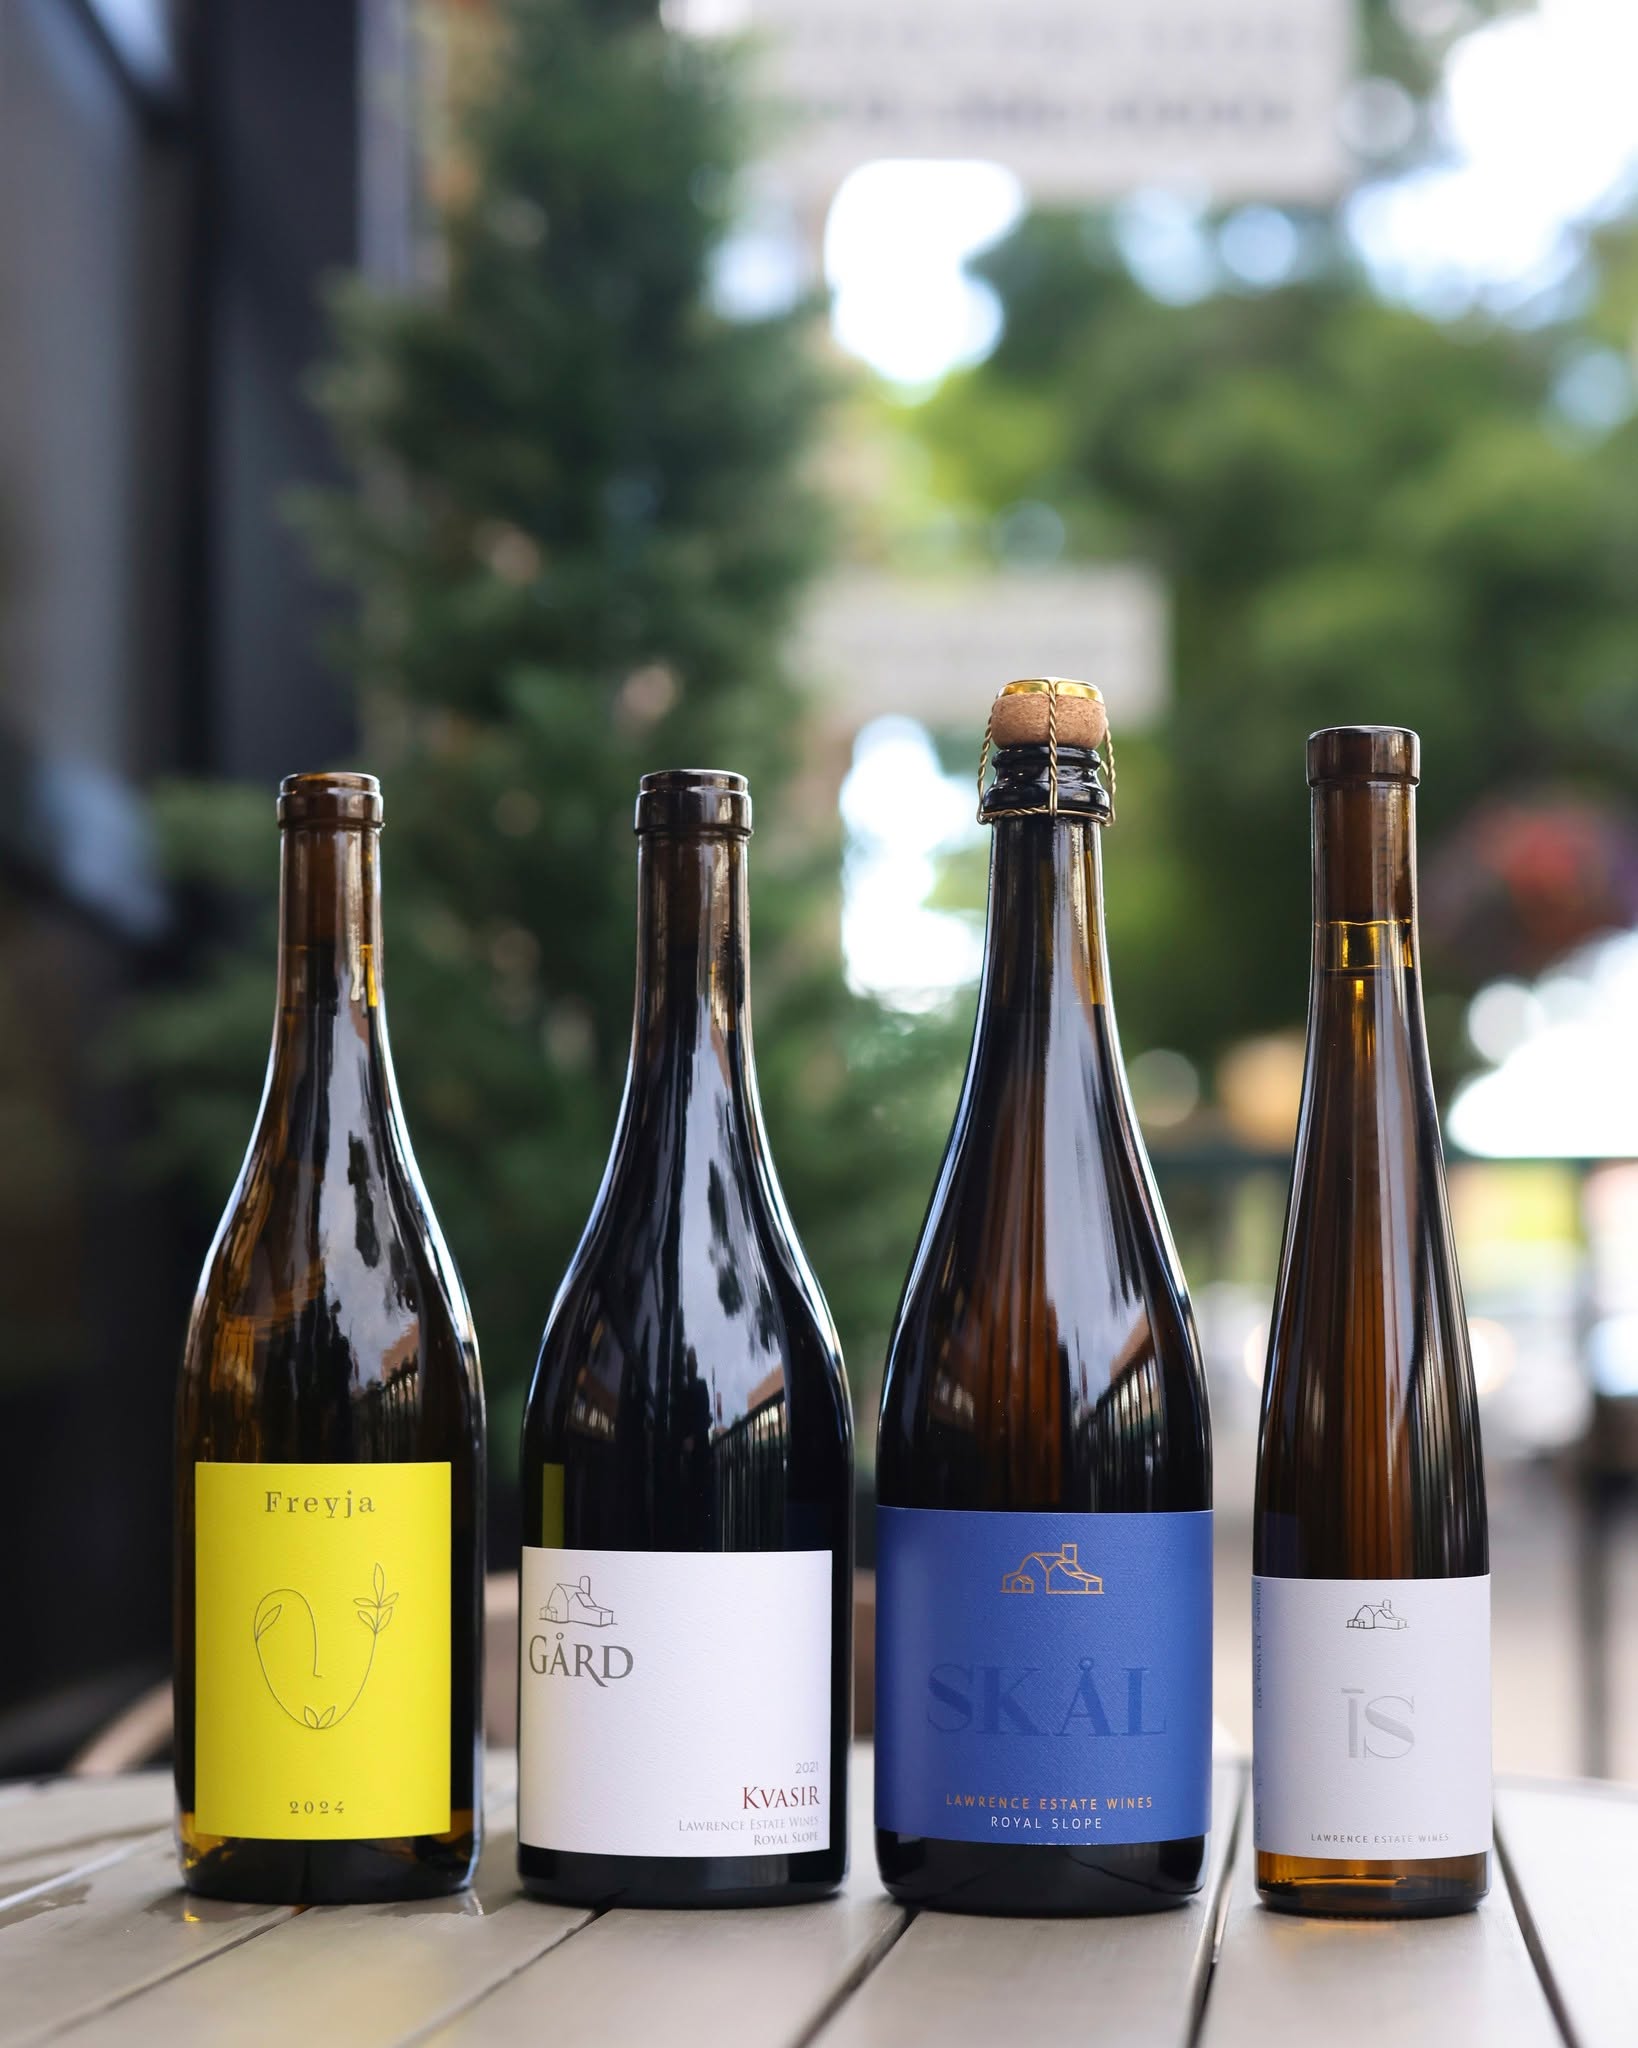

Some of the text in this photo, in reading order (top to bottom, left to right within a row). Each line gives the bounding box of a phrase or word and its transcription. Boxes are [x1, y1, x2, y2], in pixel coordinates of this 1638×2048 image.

[264, 1489, 376, 1518] Freyja
[528, 1631, 635, 1688] GÅRD
[927, 1656, 1168, 1738] SKÅL
[795, 1761, 819, 1774] 2021
[742, 1785, 820, 1810] KVASIR
[946, 1794, 1153, 1811] LAWRENCE ESTATE WINES
[289, 1801, 345, 1815] 2024
[679, 1815, 819, 1832] LAWRENCE ESTATE WINES
[991, 1816, 1103, 1831] ROYAL SLOPE
[754, 1831, 819, 1846] ROYAL SLOPE
[1311, 1833, 1449, 1844] LAWRENCE ESTATE WINES
